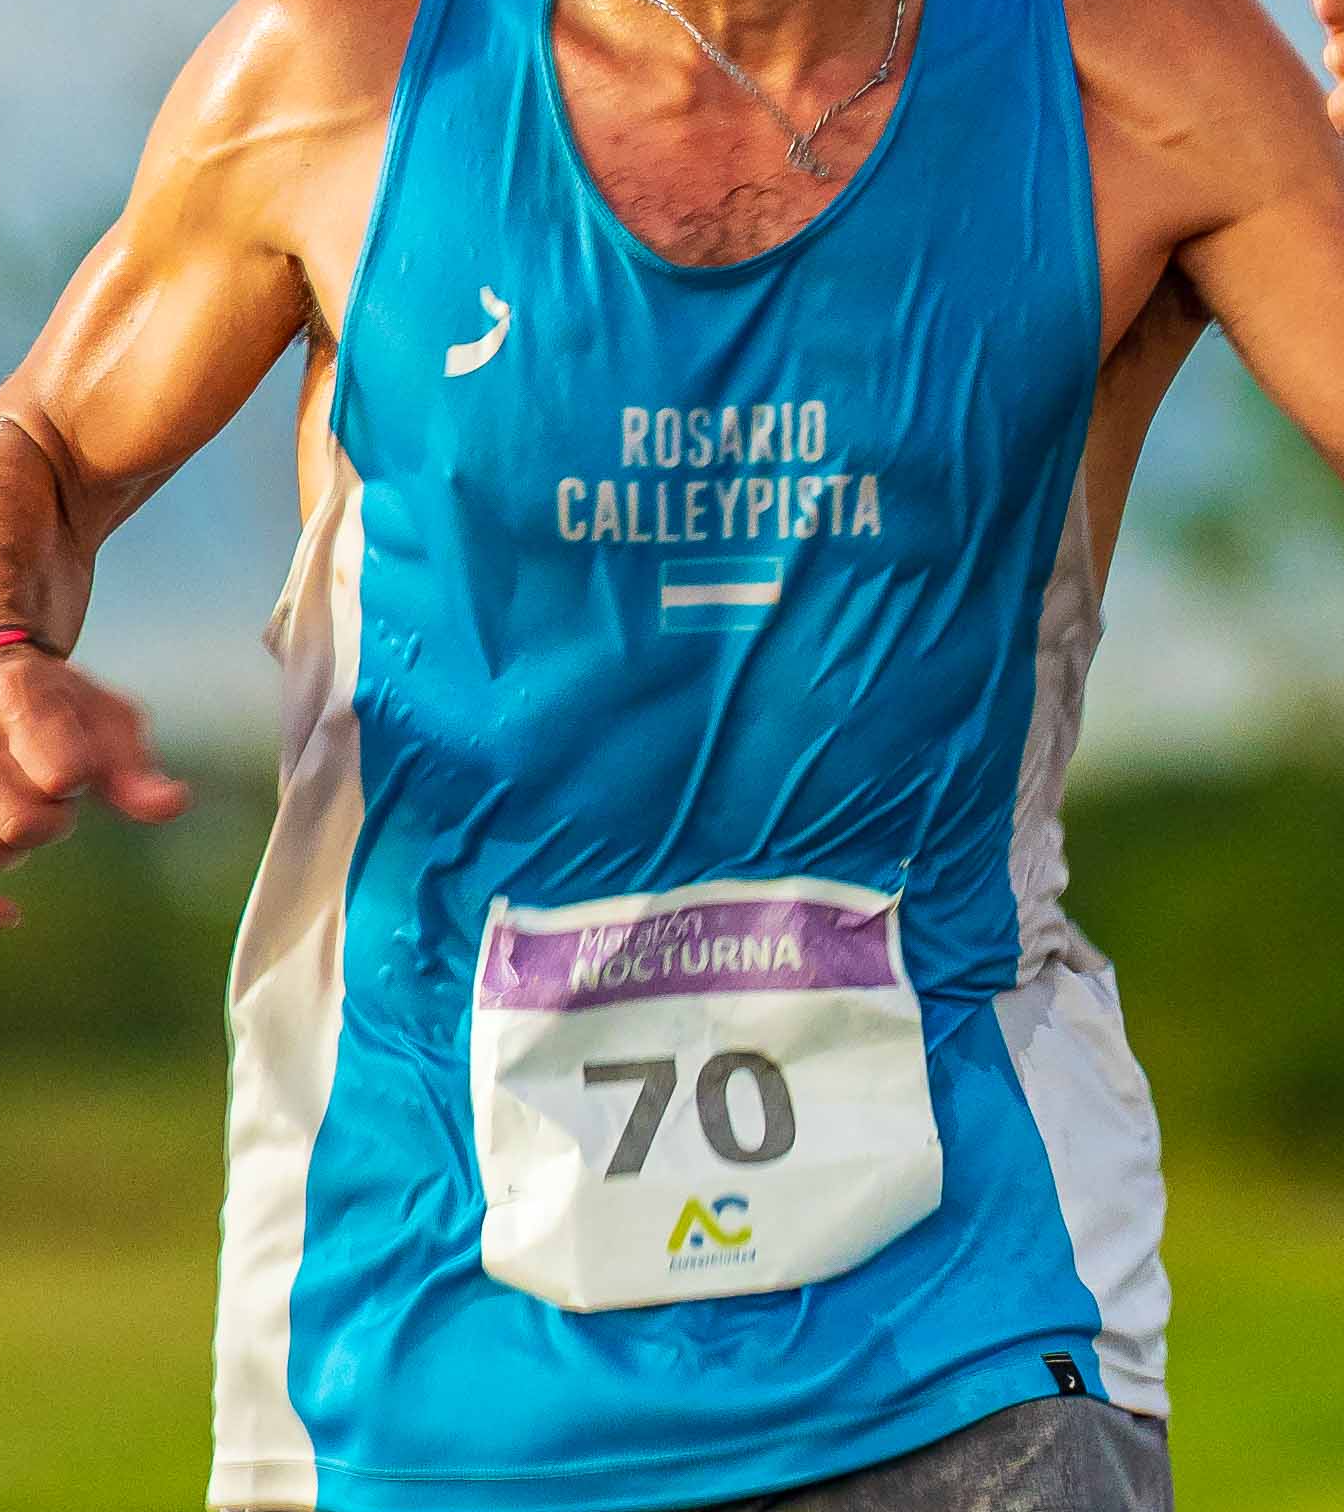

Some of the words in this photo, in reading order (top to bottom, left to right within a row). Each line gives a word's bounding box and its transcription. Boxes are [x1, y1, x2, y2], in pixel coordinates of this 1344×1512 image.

[621, 399, 827, 468] ROSARIO
[557, 474, 882, 543] CALLEYPISTA
[569, 933, 801, 992] NOCTURNA
[583, 1050, 797, 1183] 70
